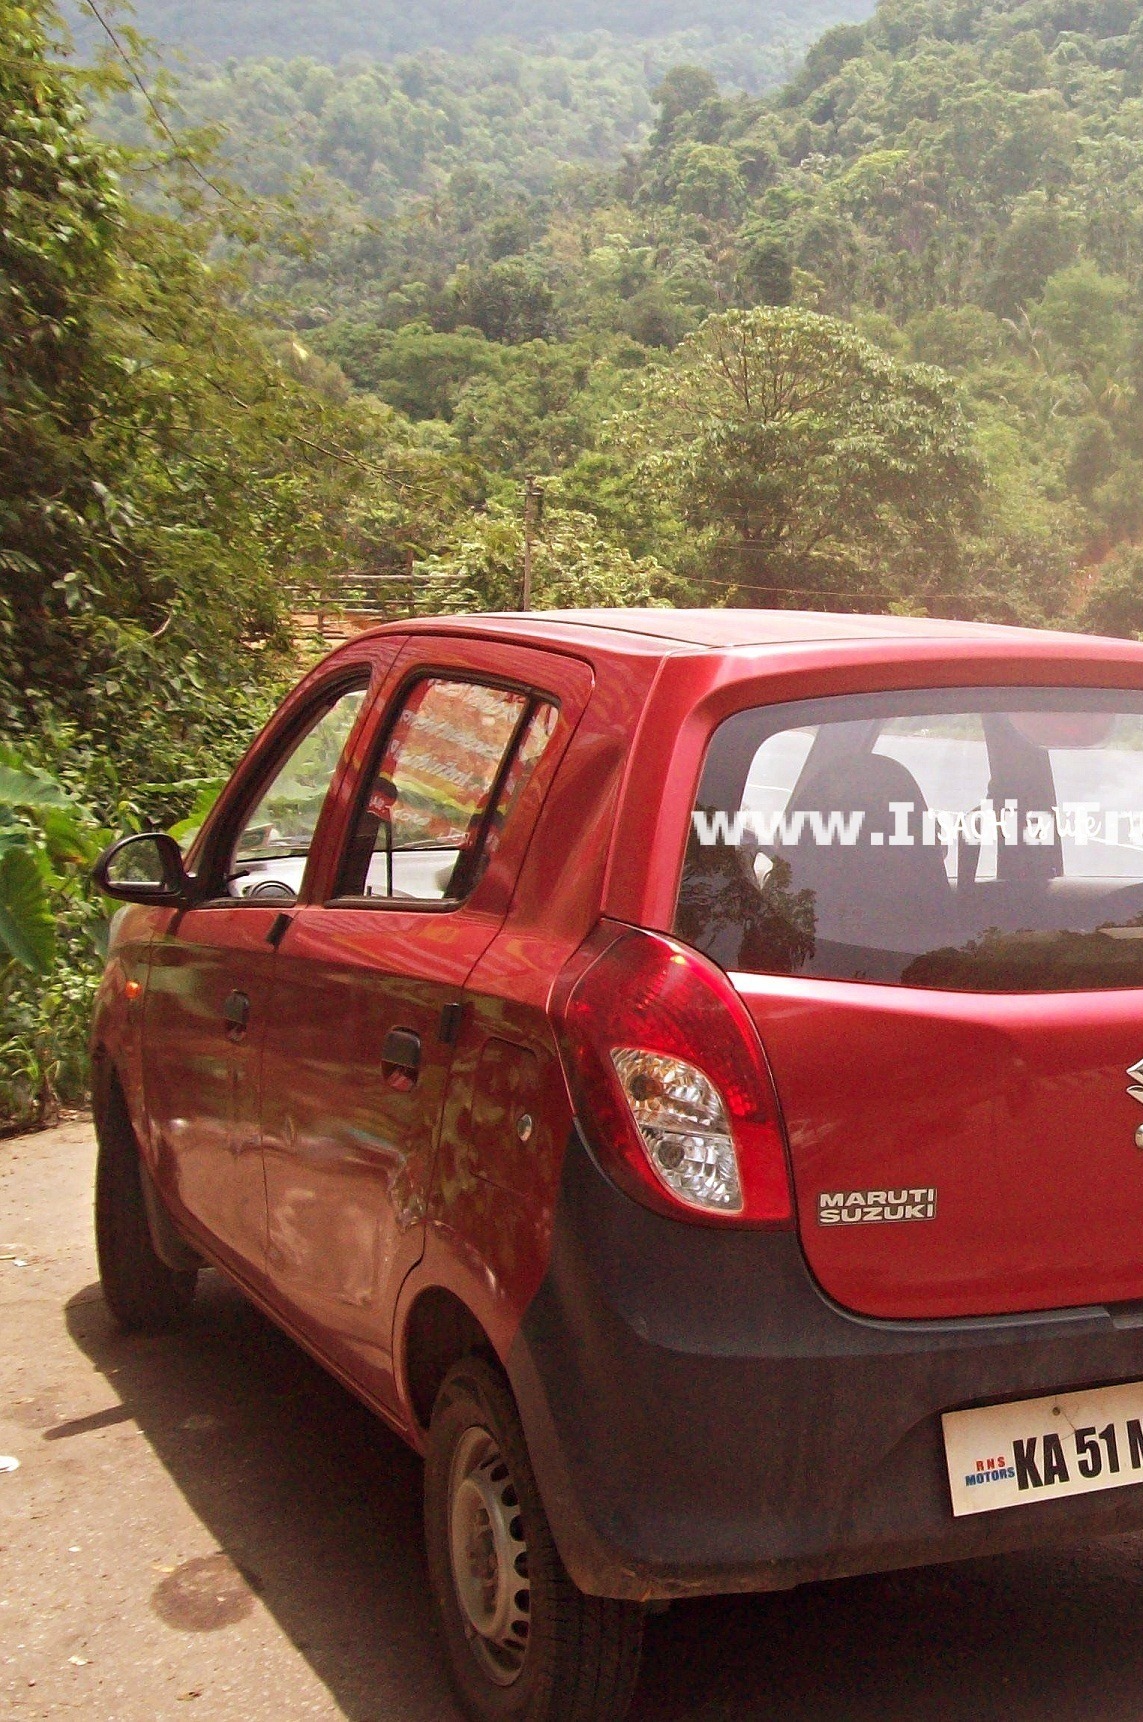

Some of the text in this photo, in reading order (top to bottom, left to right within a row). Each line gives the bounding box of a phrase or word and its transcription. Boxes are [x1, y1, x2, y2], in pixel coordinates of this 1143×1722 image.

[820, 1188, 935, 1208] MARUTI
[819, 1203, 934, 1223] SUZUKI
[1012, 1433, 1070, 1491] KA
[1075, 1423, 1120, 1479] 51
[965, 1466, 1016, 1487] MOTORS
